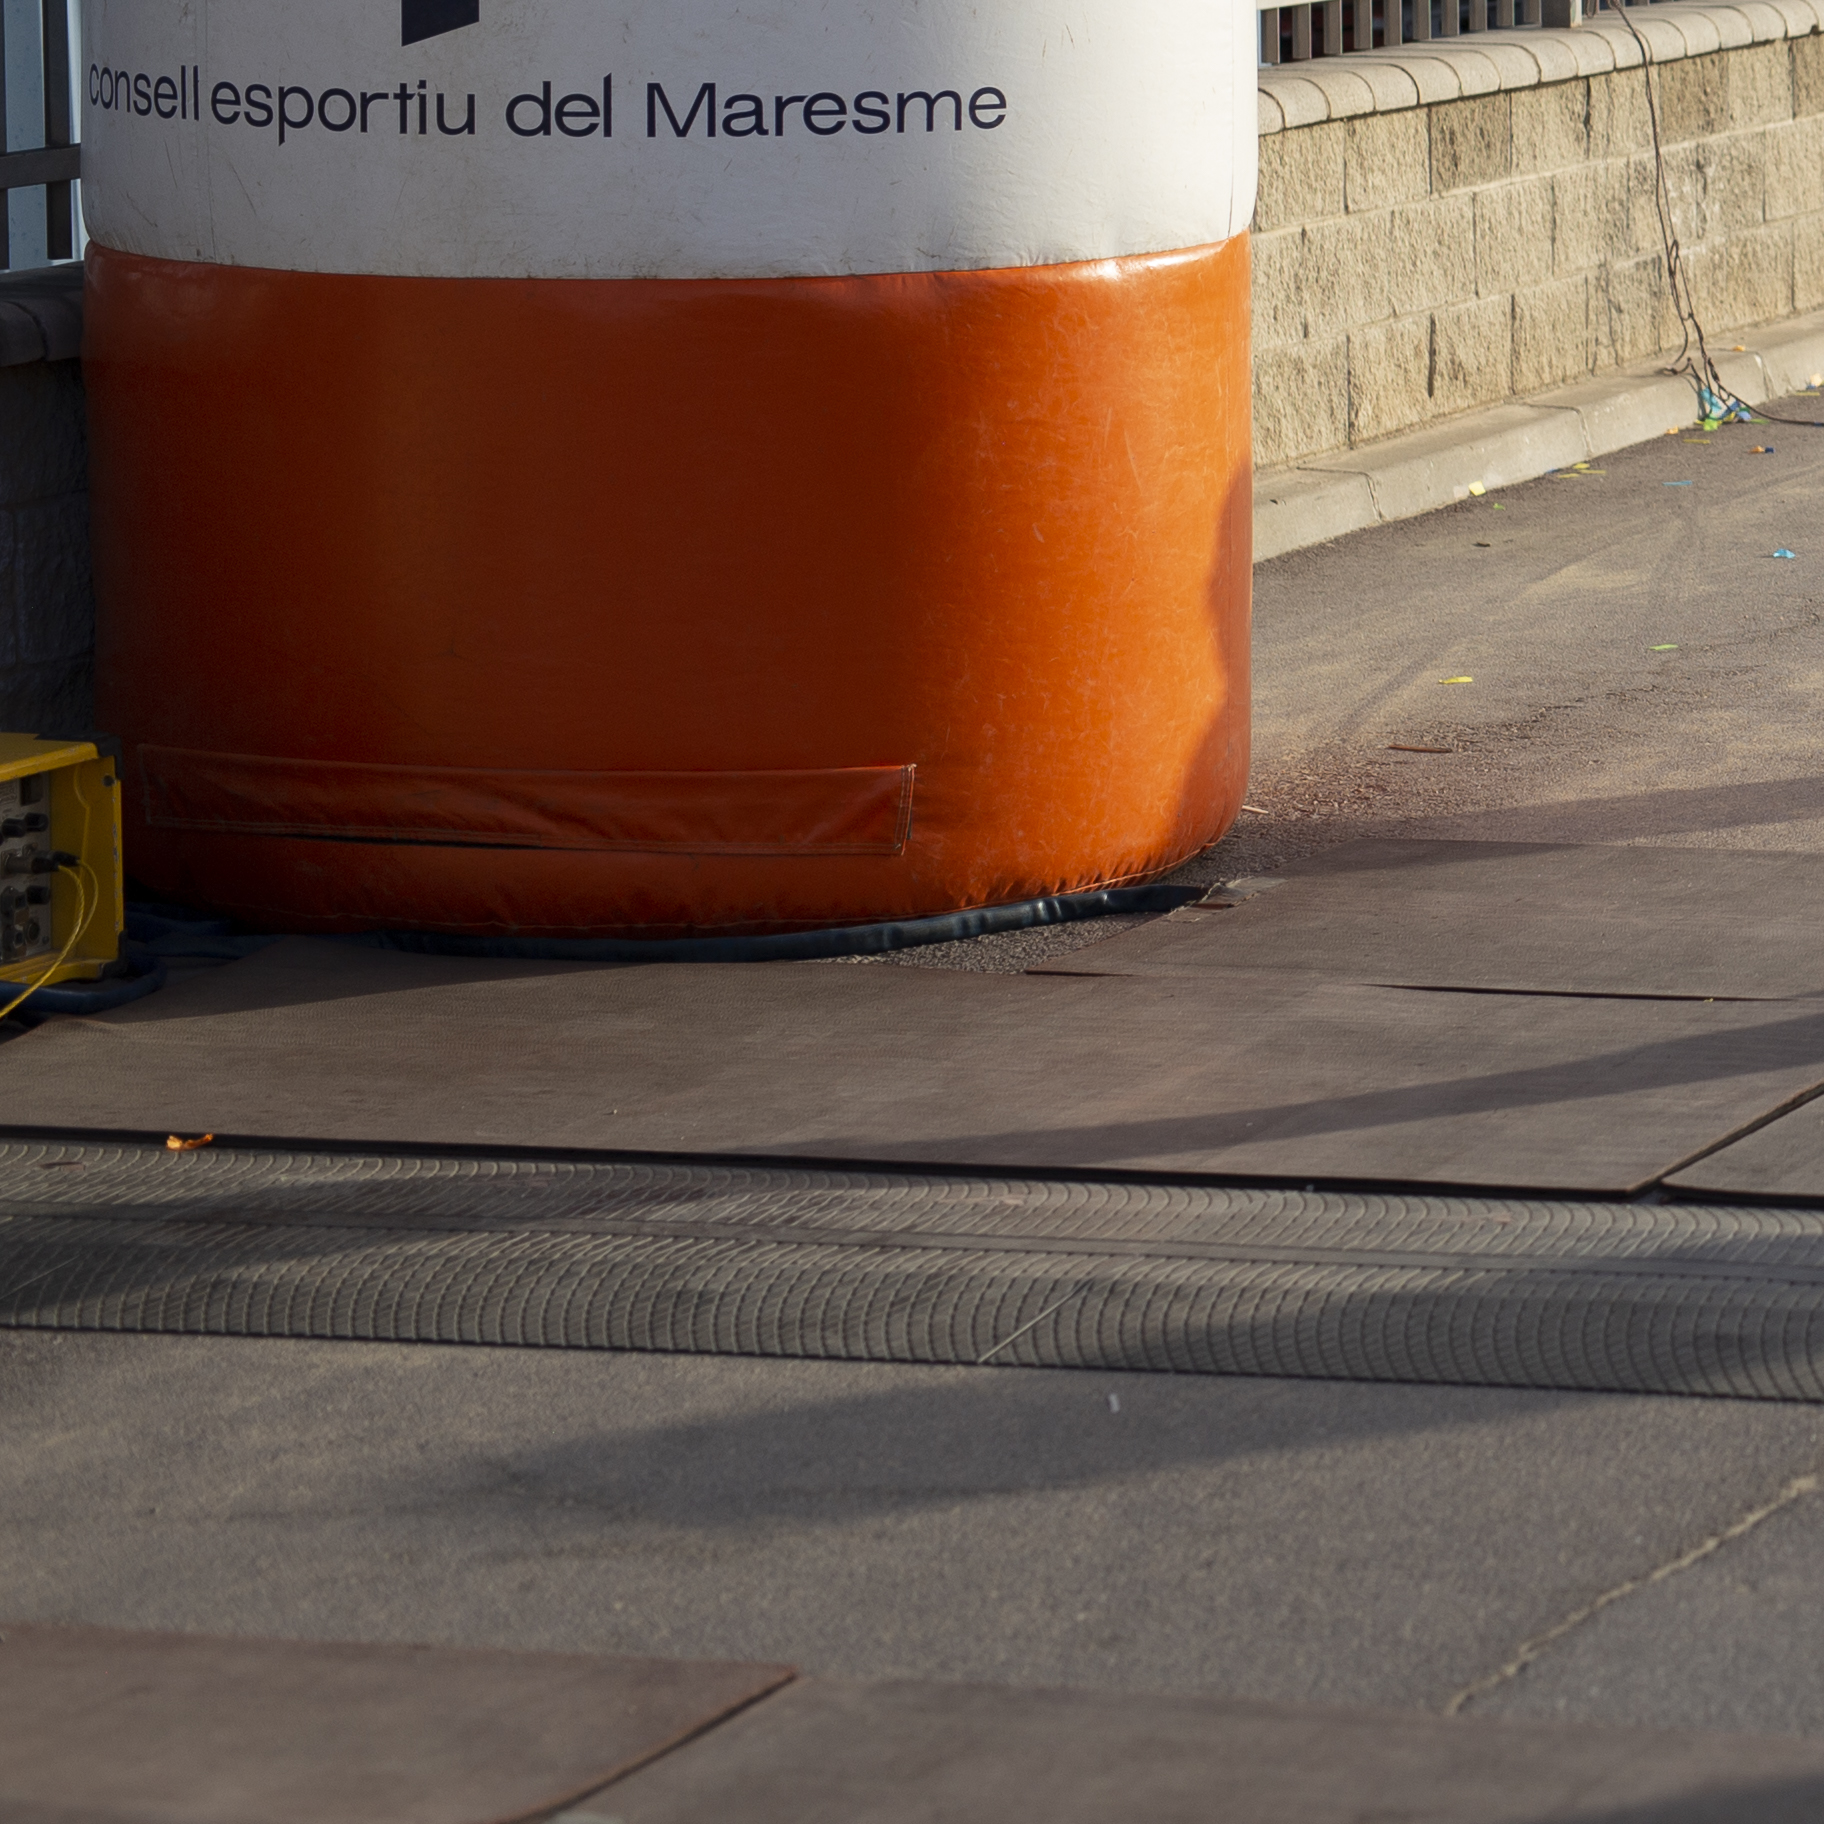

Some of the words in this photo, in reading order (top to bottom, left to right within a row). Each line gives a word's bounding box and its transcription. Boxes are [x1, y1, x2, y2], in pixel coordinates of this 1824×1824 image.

[88, 62, 200, 123] consell
[210, 79, 476, 147] esportiu
[505, 72, 612, 138] del
[646, 82, 1007, 138] Maresme
